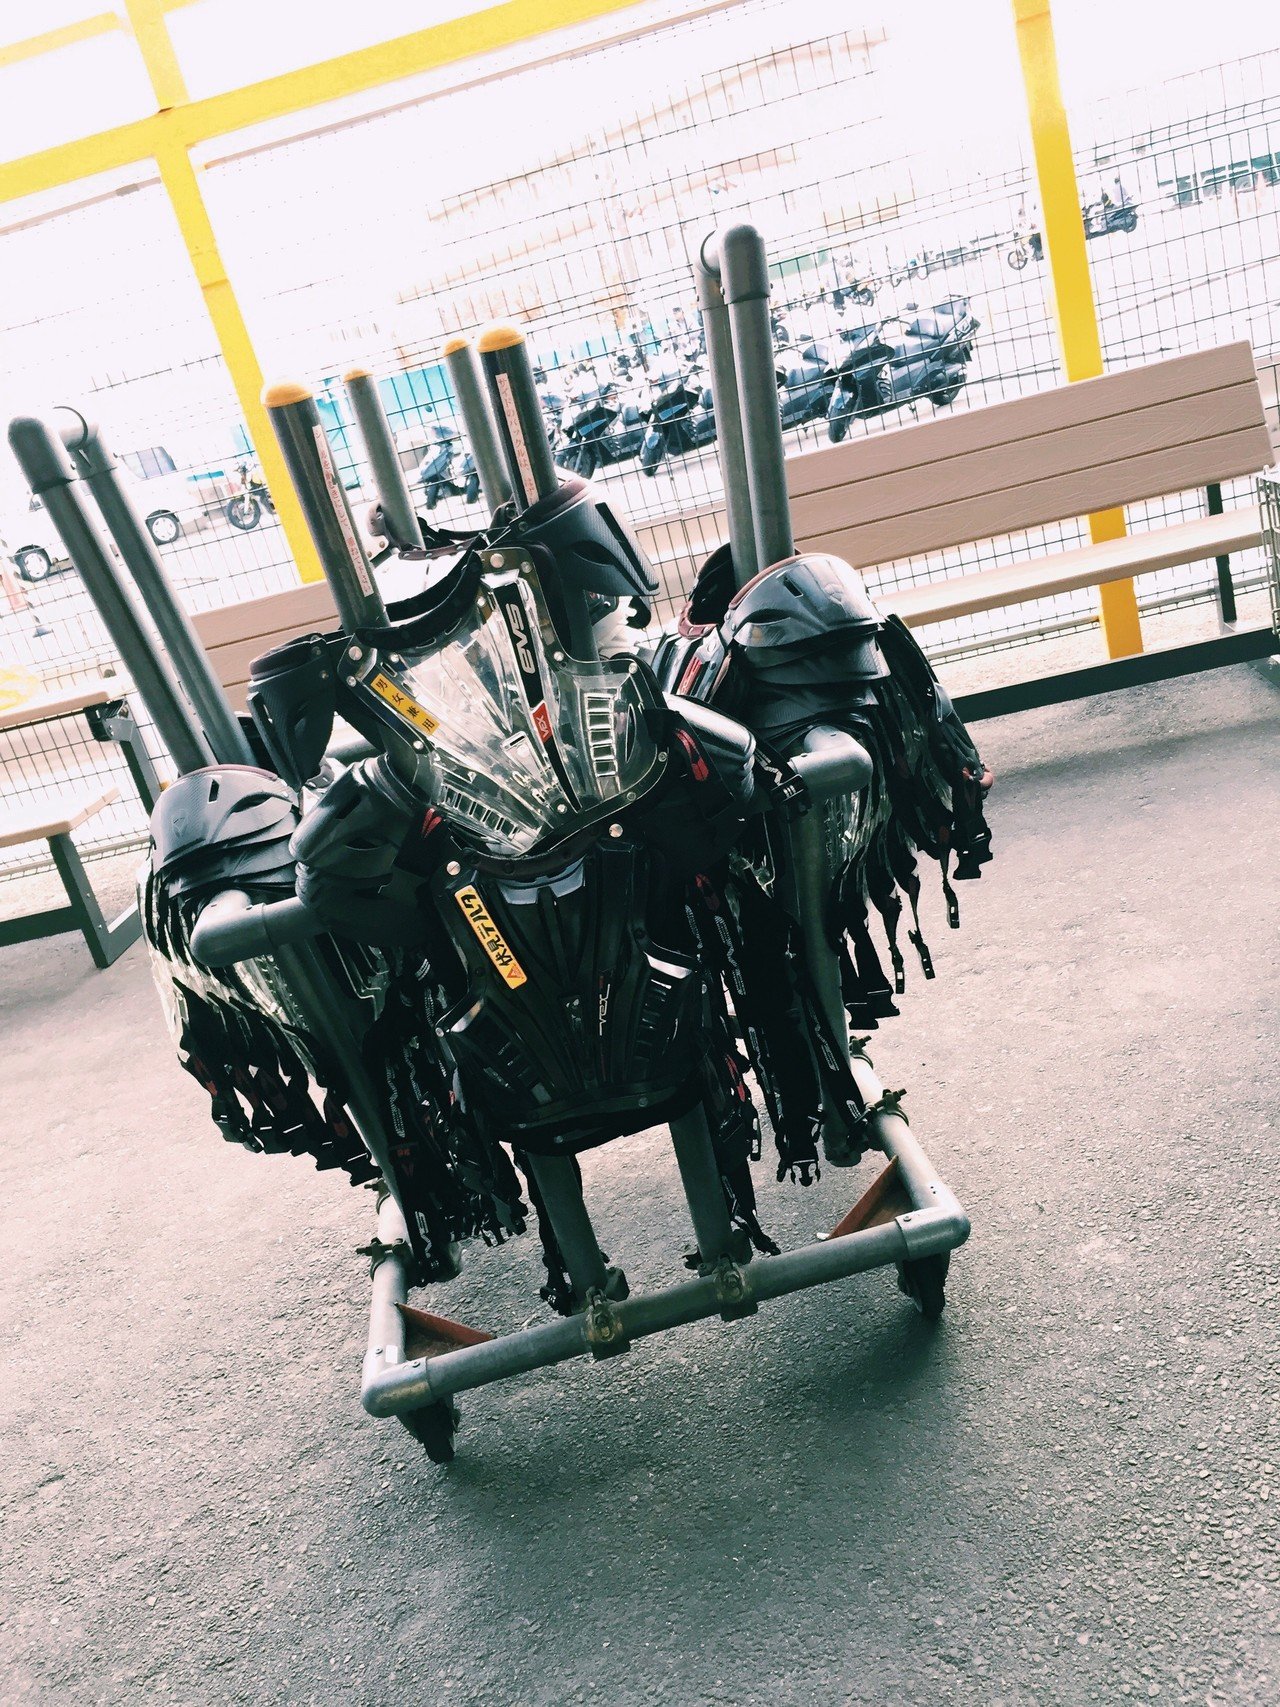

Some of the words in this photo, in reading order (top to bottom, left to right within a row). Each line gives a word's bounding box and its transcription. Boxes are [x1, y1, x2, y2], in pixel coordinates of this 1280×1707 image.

[505, 602, 536, 674] EVS
[375, 677, 436, 732] 男女兼用
[460, 892, 515, 967] 伏見デルタ
